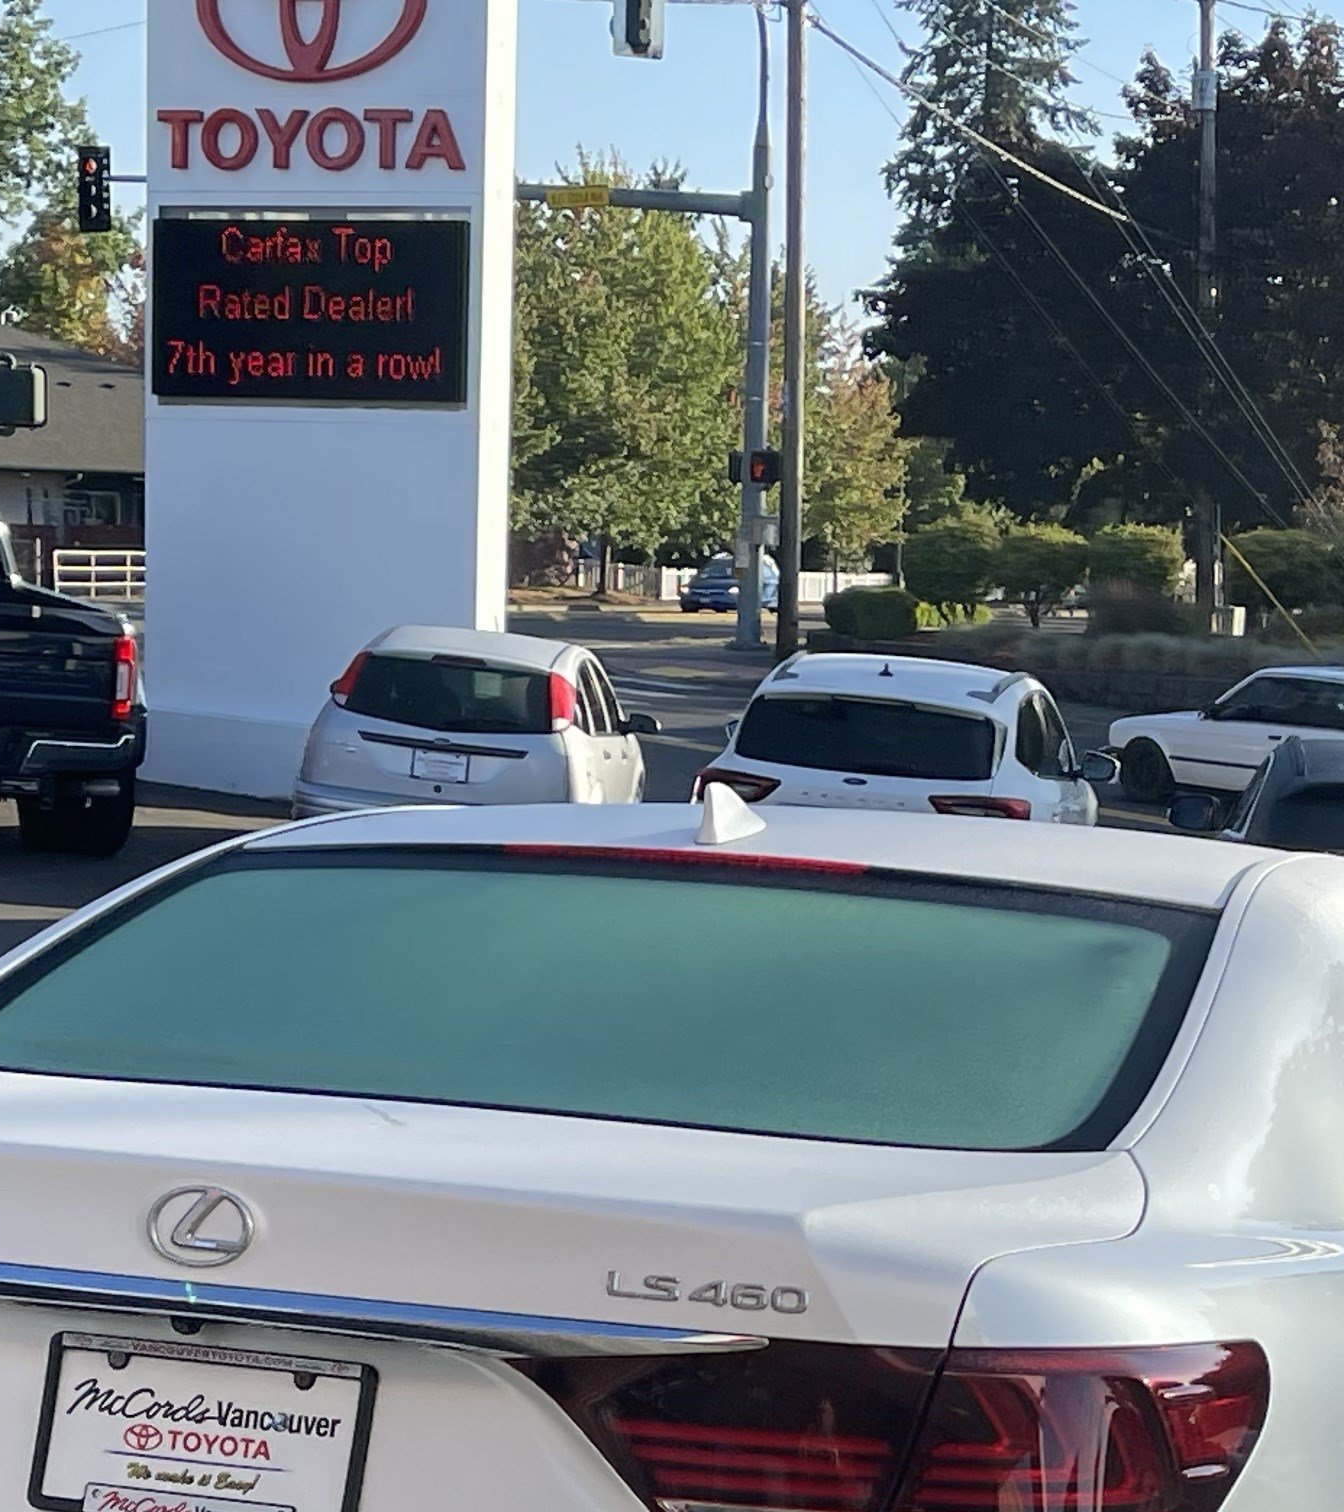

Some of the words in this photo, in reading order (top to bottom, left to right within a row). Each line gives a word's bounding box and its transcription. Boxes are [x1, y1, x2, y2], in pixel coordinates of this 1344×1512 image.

[157, 107, 466, 171] TOYOTA
[220, 226, 321, 264] Carfax
[331, 226, 393, 272] Top
[197, 284, 291, 321] Rated
[302, 284, 415, 322] Dealer!
[166, 340, 216, 376] 7th
[229, 349, 297, 385] year
[307, 347, 334, 377] in
[346, 354, 365, 377] a
[377, 347, 443, 381] row!
[606, 1269, 681, 1302] LS
[687, 1279, 811, 1315] 460
[168, 1430, 271, 1461] TOYOTA
